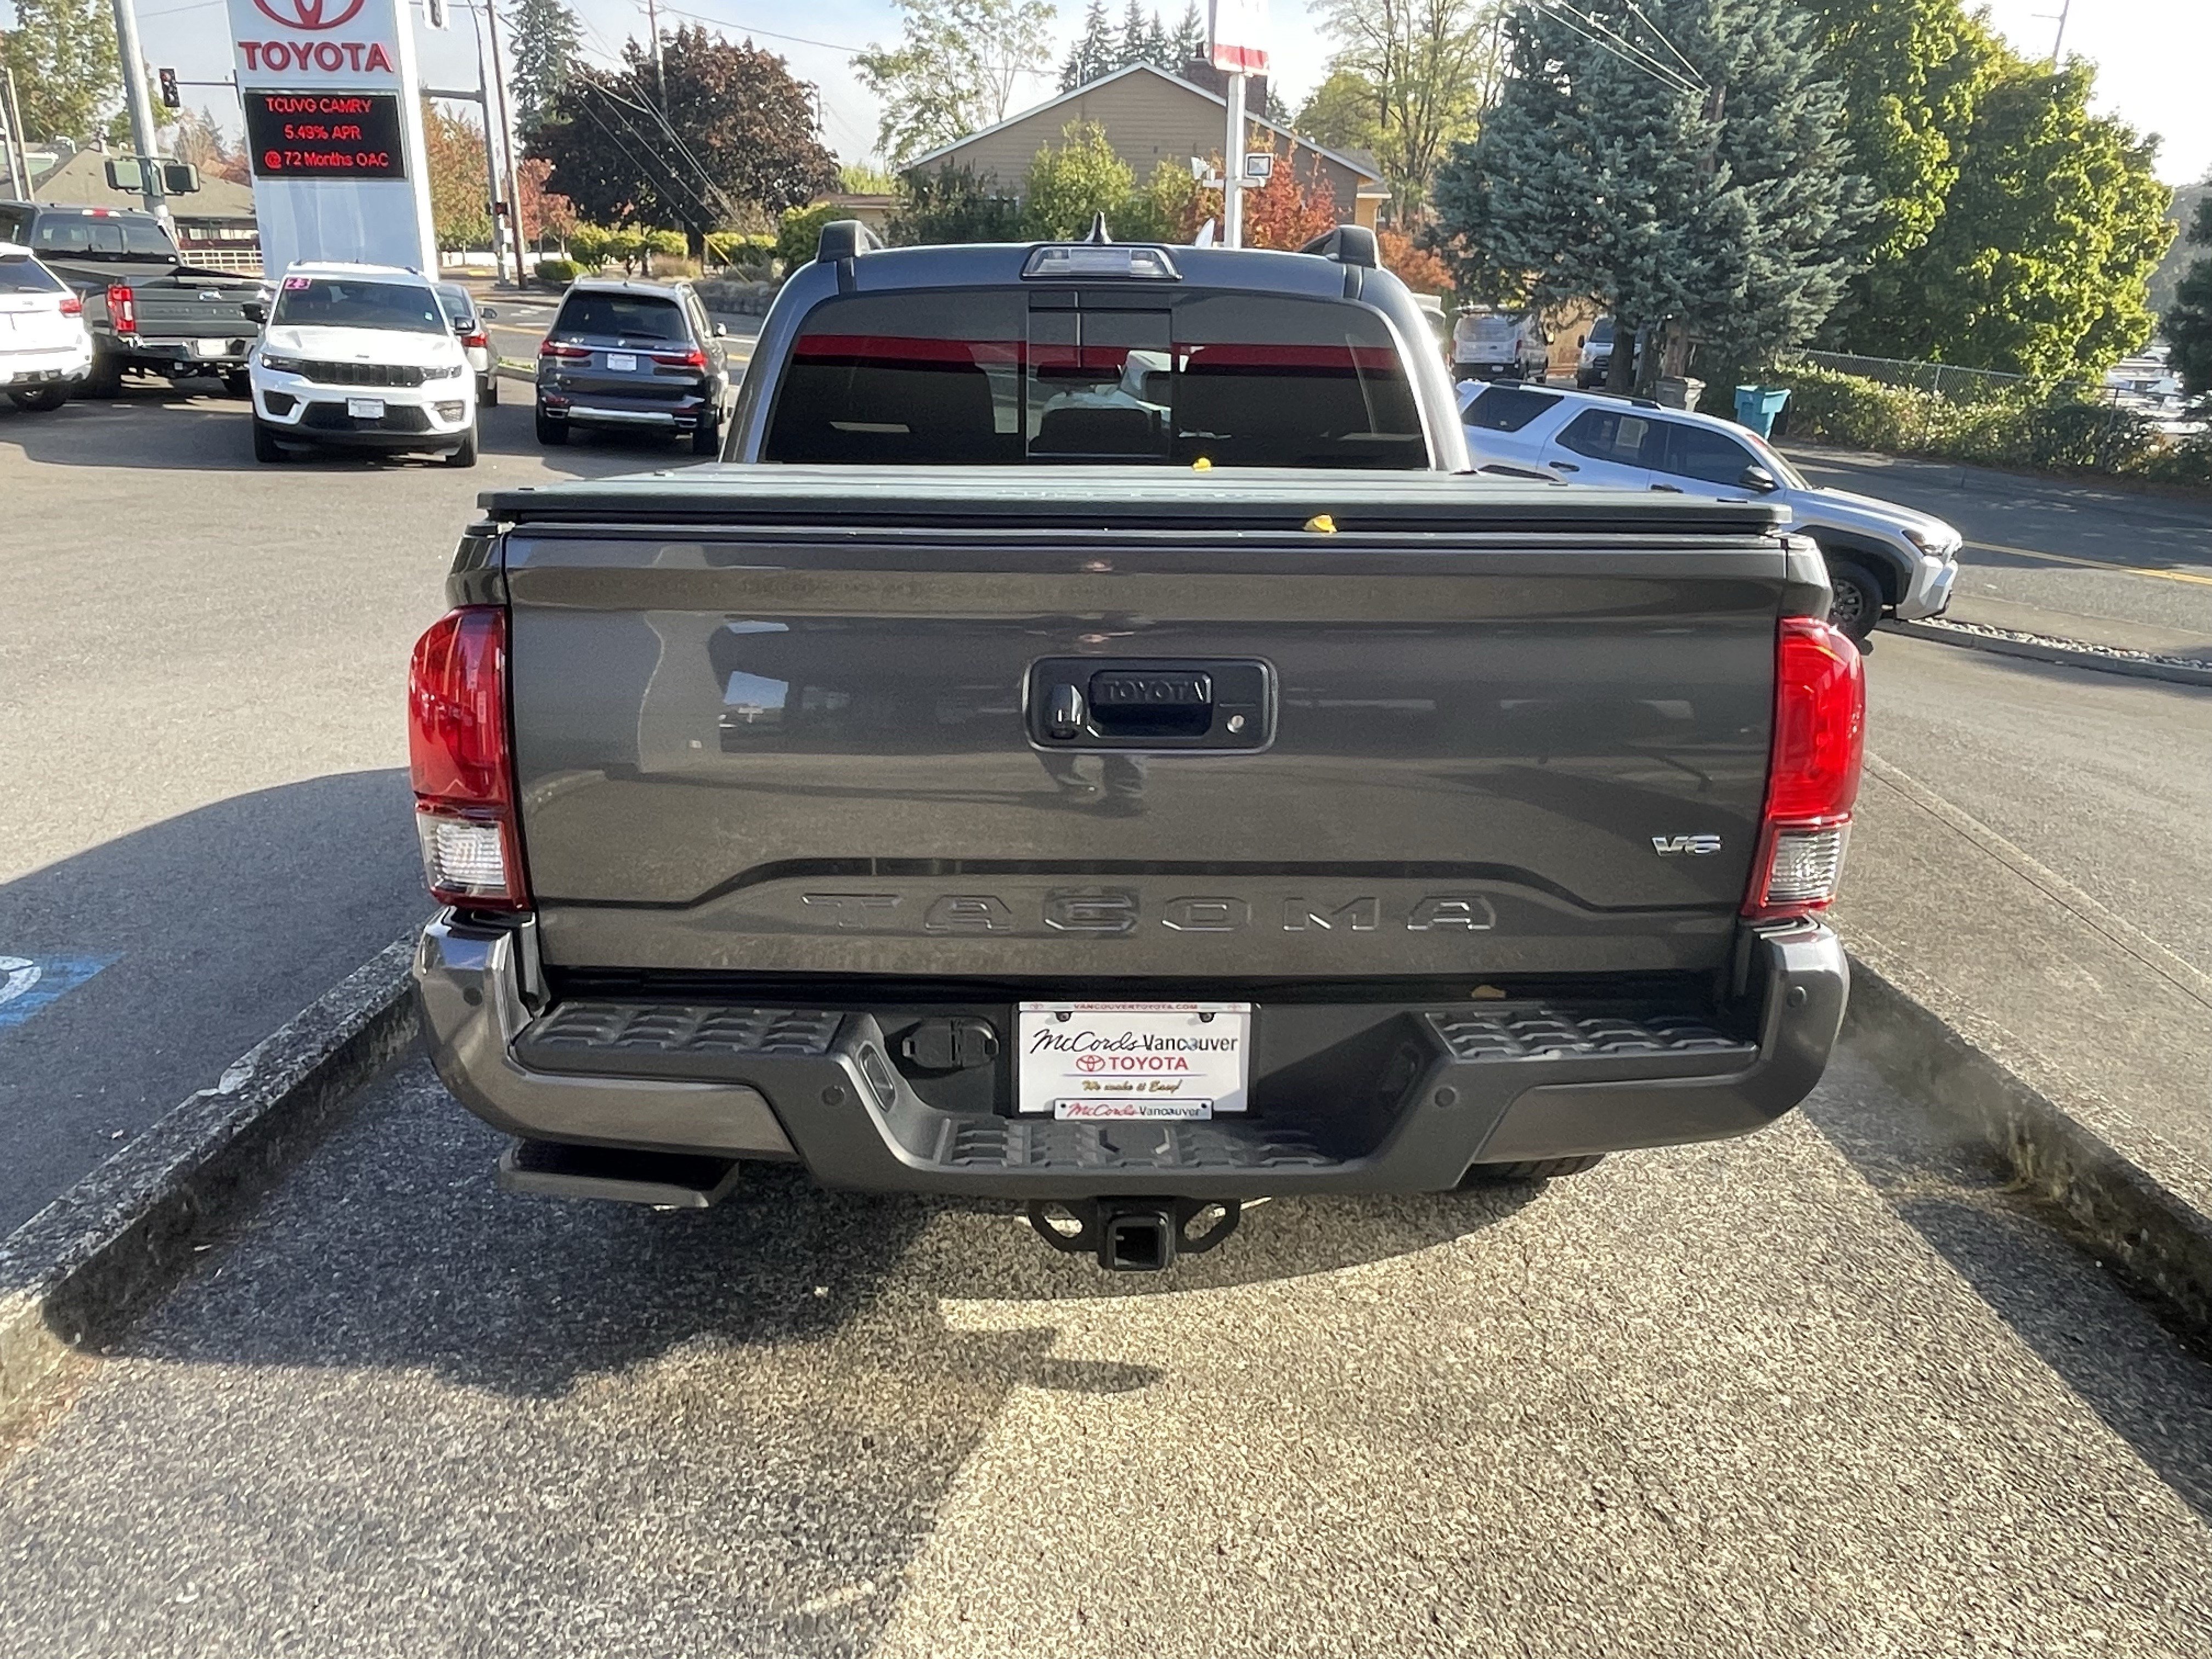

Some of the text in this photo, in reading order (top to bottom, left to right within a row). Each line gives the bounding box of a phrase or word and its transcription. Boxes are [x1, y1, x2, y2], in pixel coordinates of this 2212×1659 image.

[238, 41, 394, 73] TOYOTA
[320, 98, 372, 113] CAMRY
[284, 124, 363, 140] 5.49% APR
[264, 150, 389, 170] @ 72 Months OAC
[287, 278, 309, 287] 23
[1103, 680, 1207, 703] TOYOTA
[1651, 834, 1721, 856] V6
[800, 892, 1498, 932] TACOMA
[1029, 1028, 1239, 1054] McCords Vancouver
[1108, 1056, 1189, 1071] TOYOTA
[1066, 1103, 1141, 1118] McCords
